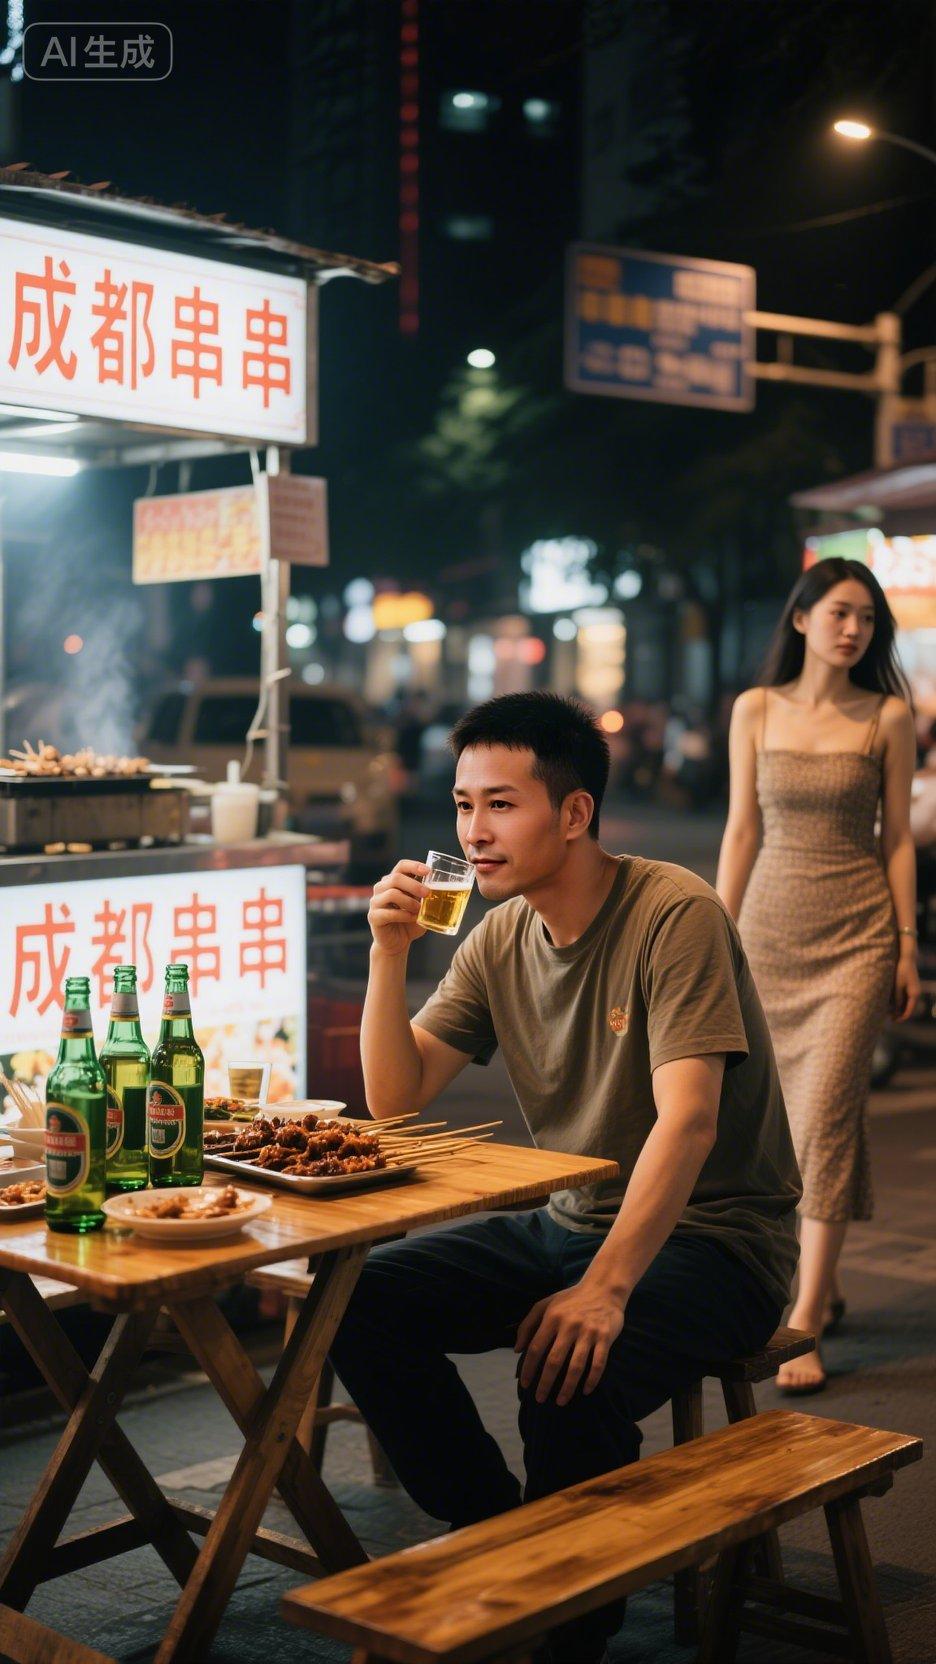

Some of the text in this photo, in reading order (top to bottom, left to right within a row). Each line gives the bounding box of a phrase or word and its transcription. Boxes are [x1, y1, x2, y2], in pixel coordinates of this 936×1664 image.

[8, 255, 291, 408] 成都串串
[9, 887, 287, 1018] 成都串串
